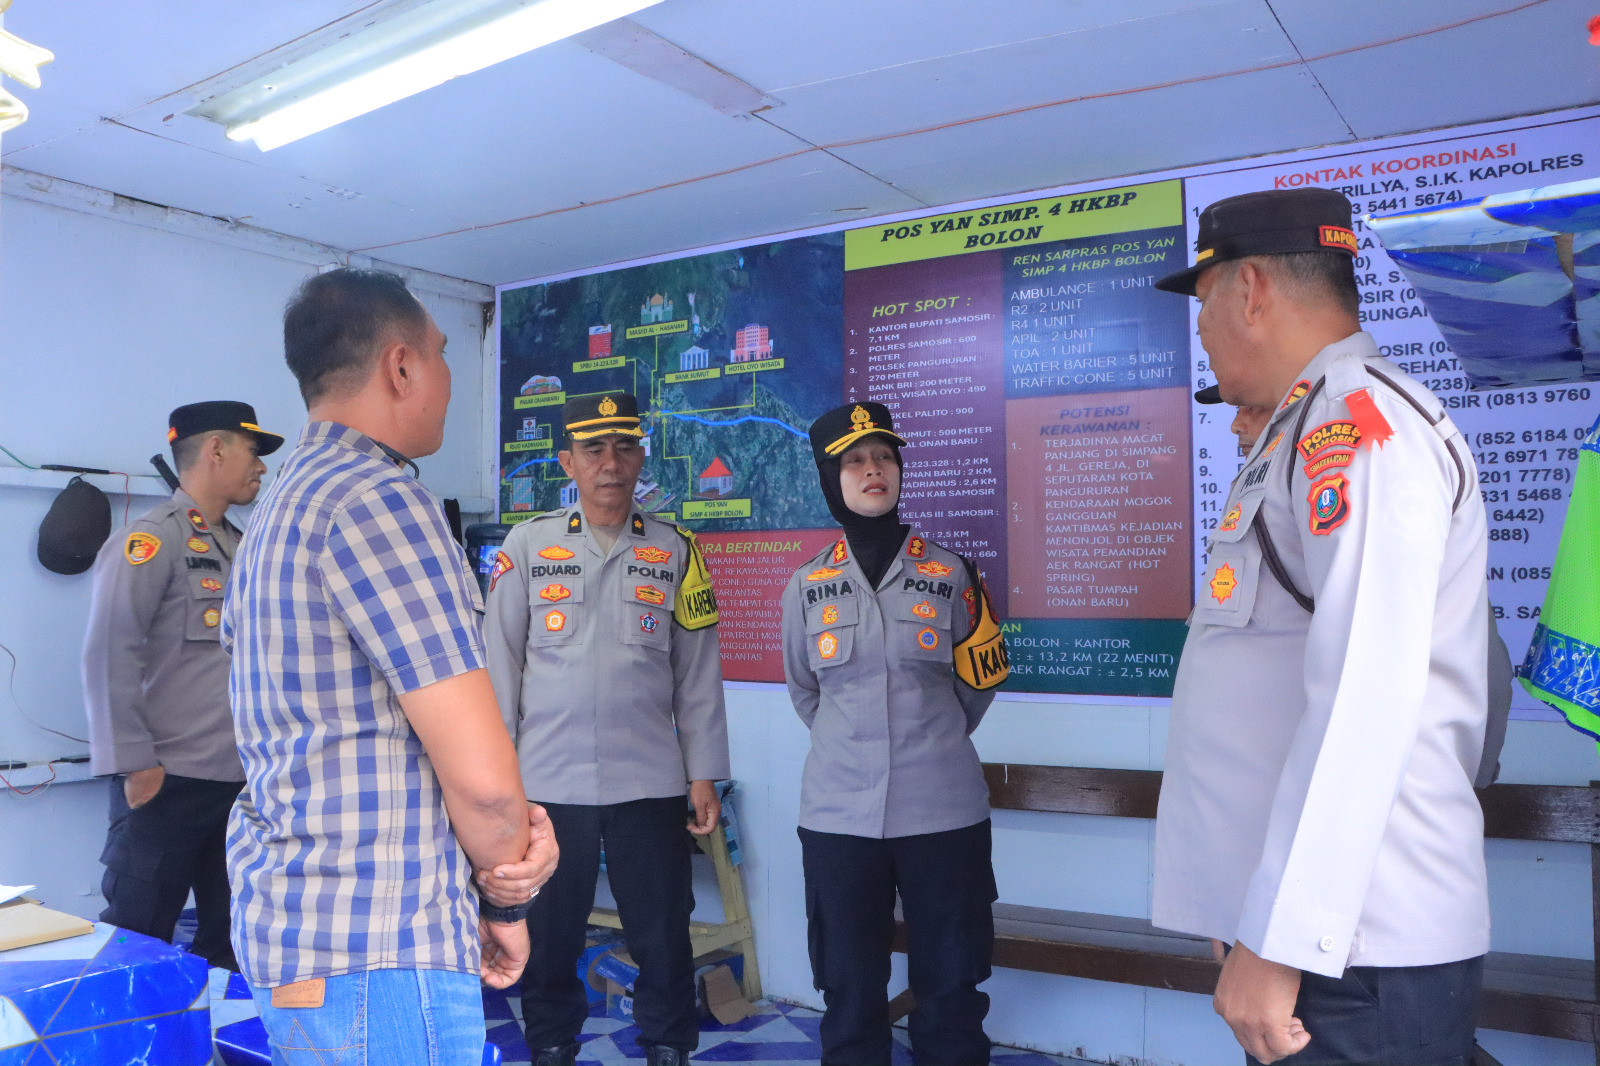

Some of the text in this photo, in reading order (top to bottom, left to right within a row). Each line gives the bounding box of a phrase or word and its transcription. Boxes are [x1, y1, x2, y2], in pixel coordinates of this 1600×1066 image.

[1274, 142, 1516, 189] KONTAK KOORDINASI
[1415, 153, 1584, 188] S.I.K. KAPOLRES
[1367, 199, 1407, 213] 5441
[1414, 189, 1463, 207] 5674)
[881, 191, 1138, 241] POS YAN SIMP. 4 HKBP
[964, 225, 1044, 249] BOLON
[1013, 236, 1176, 266] REN SARPRAS POS YAN
[1022, 252, 1166, 278] SIMP 4 HKBP BOLON
[1010, 275, 1155, 301] AMBULANCE UNIT
[872, 296, 960, 317] HOT SPOT
[1039, 299, 1083, 312] 2 UNIT
[869, 313, 991, 333] KANTOR BUPATI SAMOSIR
[1011, 315, 1076, 330] R4 UNIT
[884, 334, 900, 342] KM
[1011, 328, 1096, 345] APIL 2 UNIT
[869, 335, 977, 353] POLRES SAMOSIR 600
[1012, 343, 1094, 359] TOA UNIT
[869, 354, 900, 362] METER
[869, 355, 976, 373] POLSEK PANGURURAN
[1012, 351, 1176, 375] WATER BARIER 5 UNIT
[728, 360, 781, 373] HOTEL WISATA
[1197, 360, 1210, 372] 5.
[869, 371, 919, 382] 270 METER
[1012, 366, 1175, 389] TRAFFIC CONE 5 UNIT
[869, 376, 972, 392] BANK BRI 200 METER
[869, 385, 986, 402] HOTEL WISATA OYO 490
[1486, 387, 1591, 410] (0813 9760
[914, 409, 948, 419] PALITO
[955, 406, 974, 414] 900
[1060, 405, 1130, 420] POTENSI
[1198, 412, 1211, 424] 7.
[958, 426, 992, 435] METER
[1040, 420, 1140, 437] KERAWANAN
[919, 440, 948, 448] ONAN
[950, 437, 977, 446] BARU
[1044, 433, 1165, 449] TERJADINYA MACAT
[1475, 431, 1515, 448] (852
[1521, 428, 1567, 443] 6184
[1309, 435, 1356, 455] SAMOSIR
[1044, 446, 1177, 461] PANJANG DI SIMPANG
[1199, 447, 1212, 459] 8.
[1504, 450, 1547, 464] 6971
[973, 457, 989, 465] KM
[1056, 459, 1149, 472] JL. GEREJA, DI
[902, 467, 992, 478] ONAN BARU KM
[1199, 466, 1212, 477] 9.
[1518, 468, 1571, 483] 7778)
[981, 477, 997, 485] KM
[1045, 471, 1155, 486] SEPUTARAN KOTA
[927, 489, 946, 498] KAB
[949, 488, 995, 497] SAMOSIR
[1045, 486, 1129, 498] PANGURURAN
[1200, 482, 1222, 494] 10.
[1517, 488, 1562, 502] 5468
[1045, 496, 1173, 510] KENDARAAN MOGOK
[1201, 500, 1222, 512] 11.
[902, 509, 994, 518] KELAS SAMOSIR
[1045, 511, 1117, 522] GANGGUAN
[1493, 508, 1544, 524] 6442)
[953, 530, 969, 538] KM
[1046, 521, 1183, 534] KAMTIBMAS KEJADIAN
[972, 540, 988, 548] KM
[1045, 533, 1176, 546] MENONJOL DI OBJEK
[725, 541, 802, 554] BERTINDAK
[979, 550, 997, 558] 660
[1046, 547, 1167, 559] WISATA PEMANDIAN
[736, 556, 755, 564] PAM
[1046, 559, 1161, 570] AEK RANGAT (HOT
[531, 565, 582, 578] EDUARD
[627, 565, 674, 583] POLRI
[725, 567, 770, 575] REKAYASA
[1046, 573, 1096, 583] SPRING)
[806, 580, 853, 604] RINA
[903, 577, 953, 600] POLRI
[1046, 585, 1138, 595] PASAR TUMPAH
[730, 599, 761, 608] TEMPAT
[1047, 597, 1129, 608] (ONAN BARU)
[720, 610, 781, 618] ARUS APABILA
[1014, 637, 1060, 648] BOLON
[1074, 638, 1131, 649] KANTOR
[1039, 652, 1174, 665] 13,2 KM (22 MENIT)
[1038, 665, 1169, 678] RANGAT 2,5 KM
